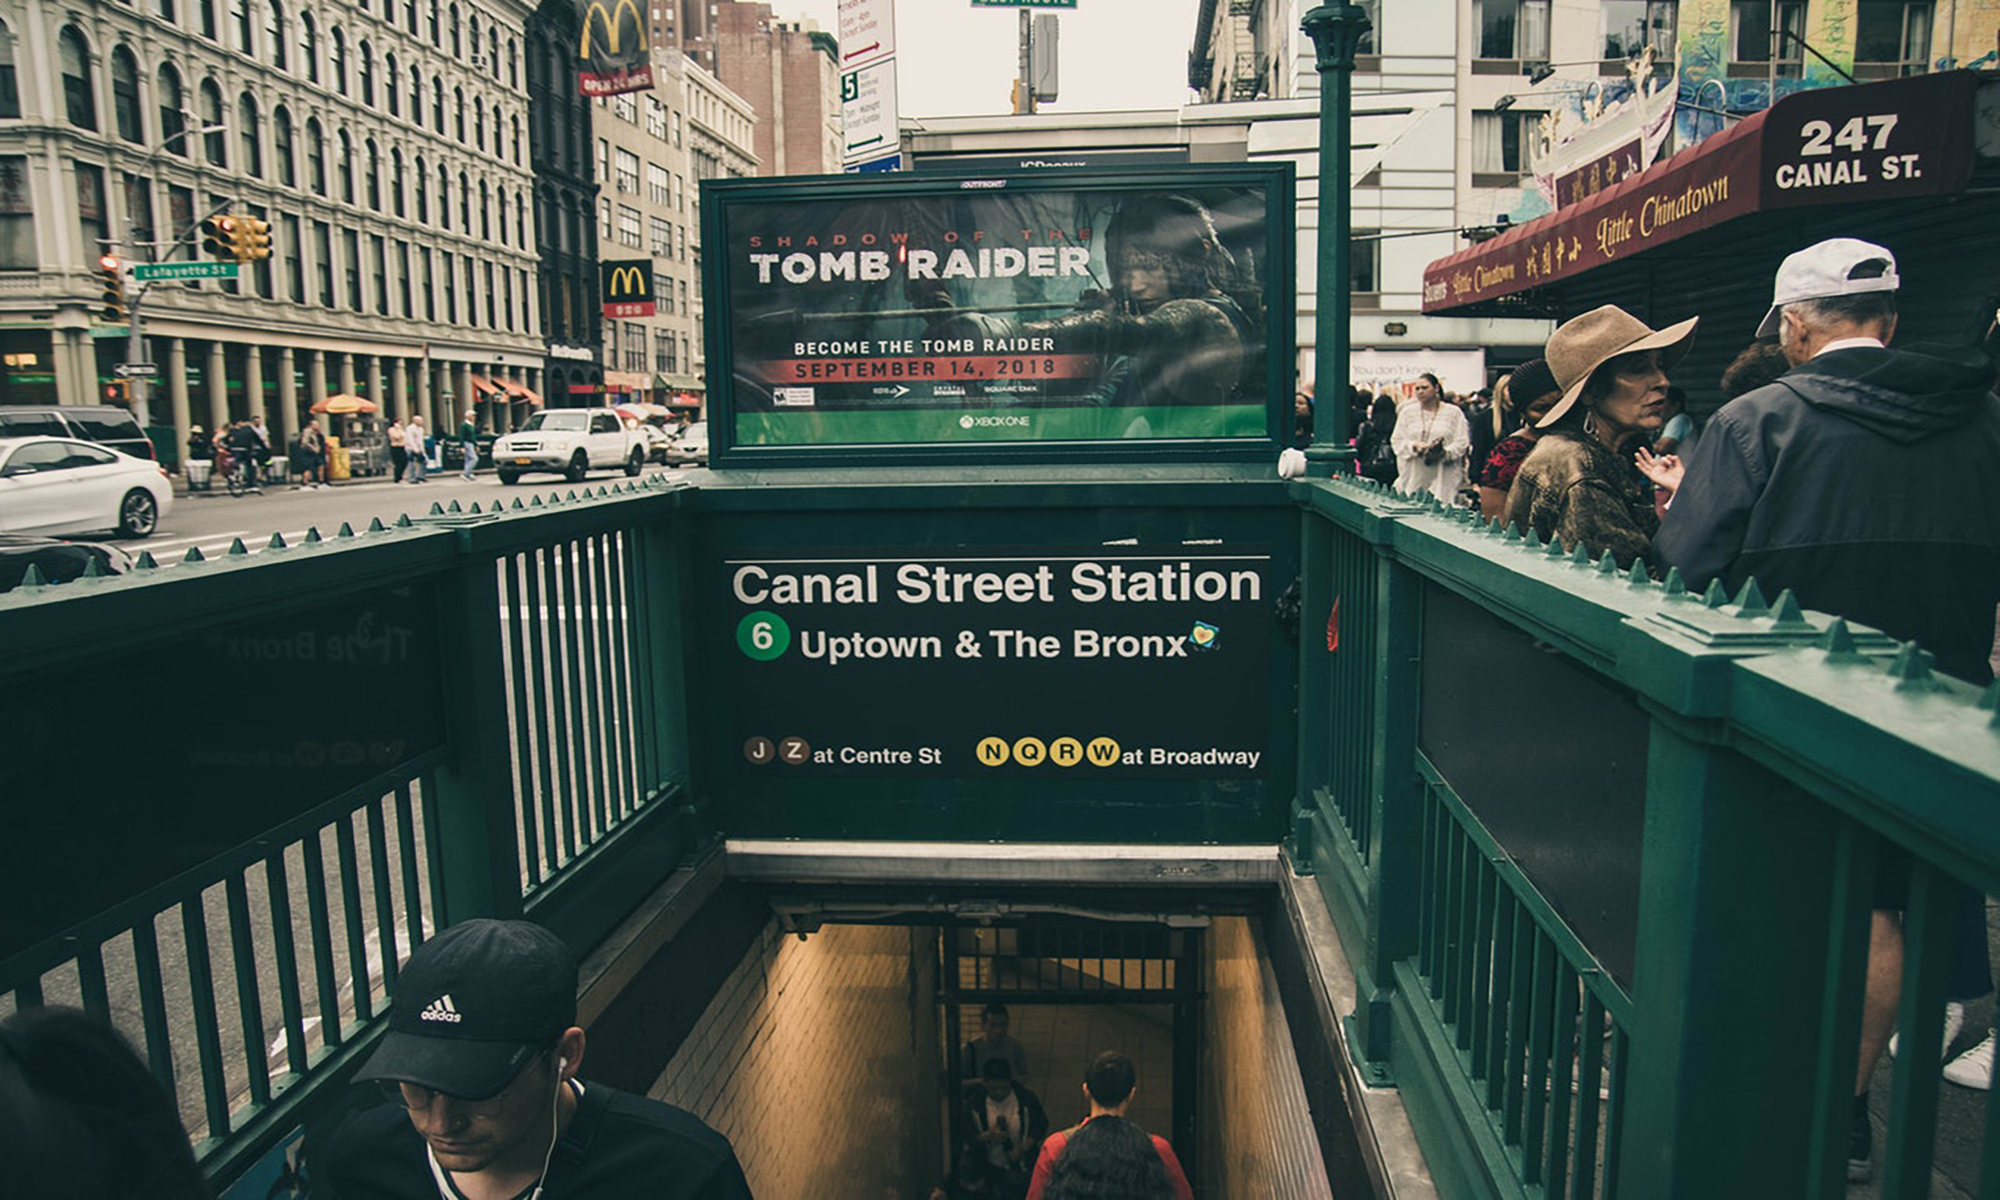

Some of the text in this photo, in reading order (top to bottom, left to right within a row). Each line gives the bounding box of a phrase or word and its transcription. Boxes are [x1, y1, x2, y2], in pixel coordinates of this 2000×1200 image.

[584, 79, 612, 92] OPEN
[845, 74, 855, 99] 5
[1800, 113, 1898, 156] 247
[1775, 154, 1922, 189] CANAL ST.
[1596, 175, 1729, 258] Little Chinatown
[750, 228, 1091, 248] SHADOW OF THE
[144, 265, 227, 279] Lafayette St
[749, 251, 891, 284] TOMB
[908, 246, 1091, 279] RAIDER
[794, 337, 1055, 356] BECOME THE TOMB RAIDER
[795, 359, 1055, 378] SEPTEMBER 14, 2018
[1353, 365, 1373, 375] You
[1377, 365, 1403, 375] don't
[975, 416, 1030, 427] XBOX ONE
[733, 562, 1261, 604] Canal Street Station
[752, 622, 1188, 665] 6 Uptown & The Bronx
[753, 742, 943, 764] J Z at Centre St
[985, 743, 1260, 768] N Q R W at Broadway
[421, 1009, 462, 1023] adidas
